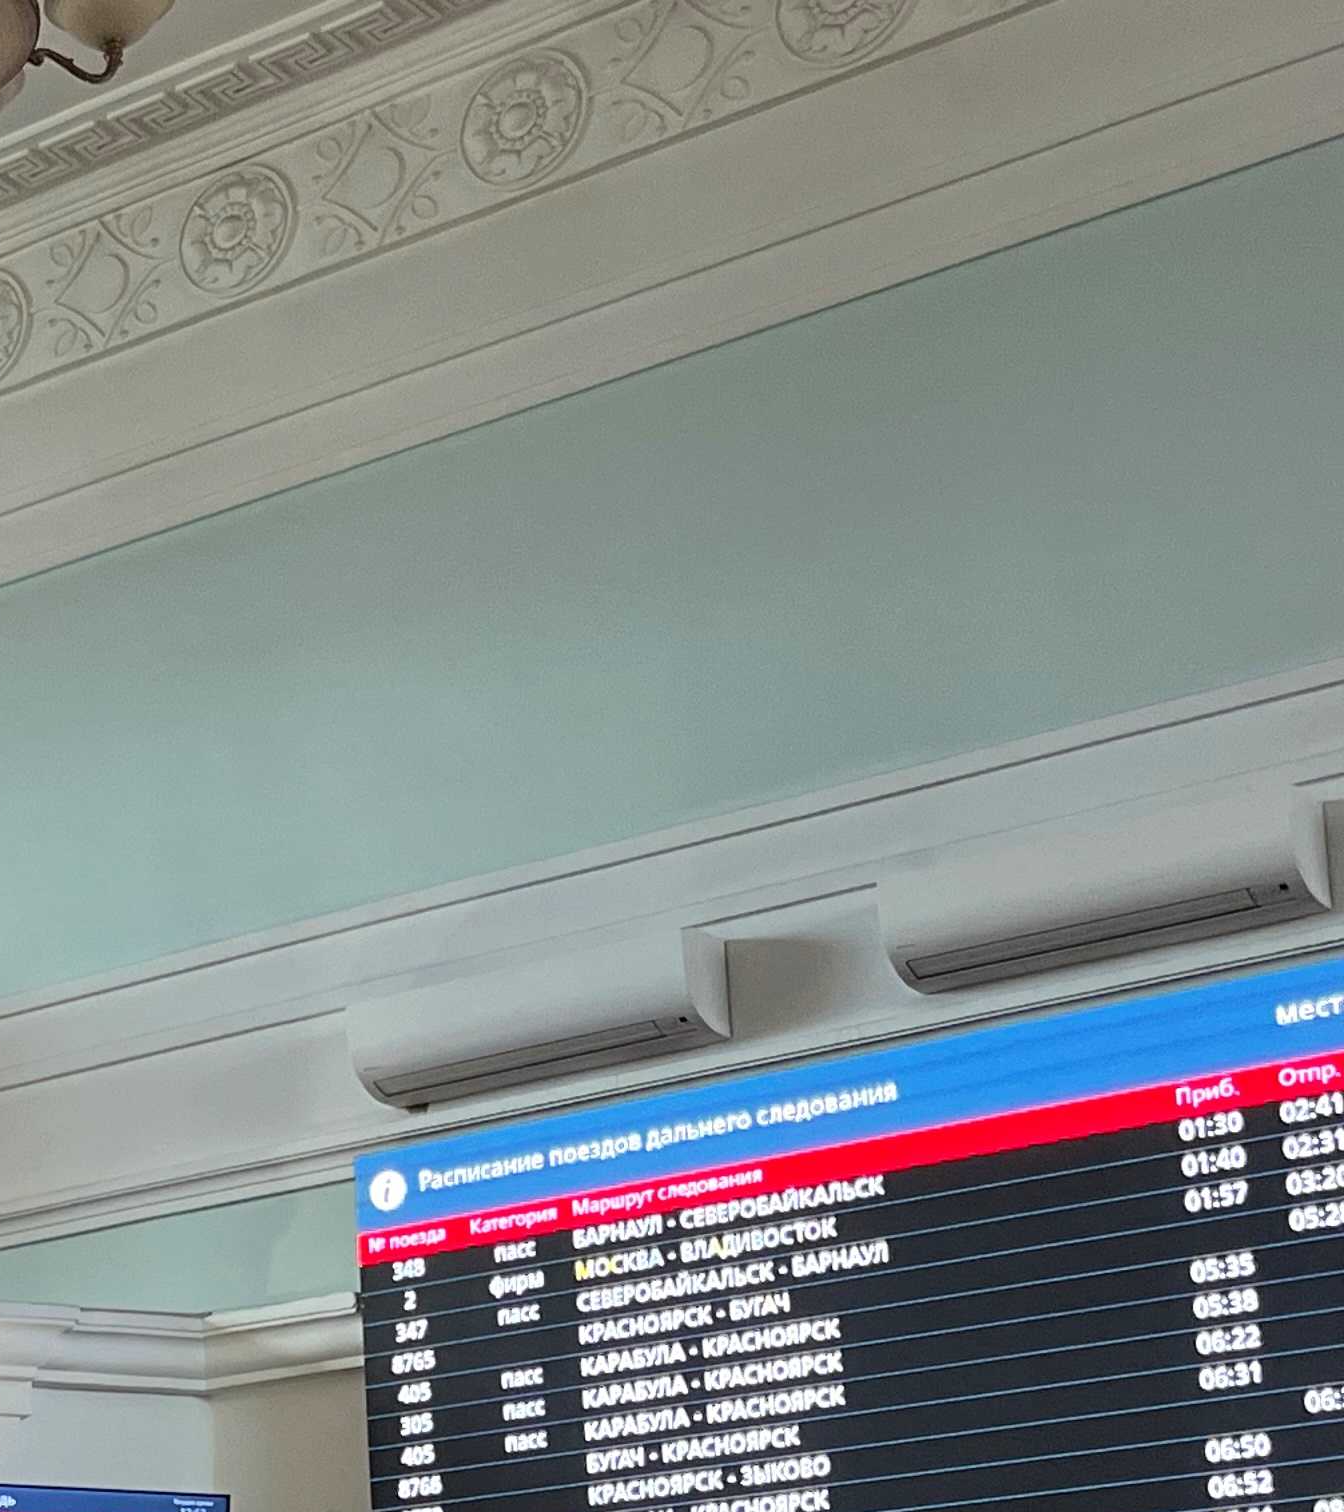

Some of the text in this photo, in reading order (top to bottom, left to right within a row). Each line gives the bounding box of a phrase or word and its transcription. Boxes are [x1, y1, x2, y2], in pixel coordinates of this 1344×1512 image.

[389, 1228, 446, 1248] поезда
[469, 1207, 557, 1234] Категория
[571, 1188, 654, 1215] Маршрут
[657, 1168, 762, 1200] следования
[1175, 1077, 1239, 1107] Приб.
[418, 1082, 897, 1191] Расписание поездов дальнего следования
[493, 1240, 536, 1263] пасс
[572, 1213, 662, 1249] БАРНАУЛ
[678, 1174, 885, 1229] СЕВЕРОБАЙКАЛЬСК
[1178, 1110, 1244, 1141] 01:30
[395, 1182, 1248, 1343] 347 пасс СЕВЕРОБАЙКАЛЬСК БАРНАУЛ 01:57
[403, 1290, 416, 1310] 2
[488, 1269, 544, 1298] фирм
[574, 1247, 664, 1281] МОСКВА
[679, 1216, 837, 1262] ВЛАДИВОСТОК
[1180, 1147, 1246, 1177] 01:40
[500, 1366, 543, 1389] пасс
[580, 1341, 686, 1376] КАРАБУЛА
[701, 1317, 841, 1358] КРАСНОЯРСК
[1189, 1253, 1255, 1283] 05:35
[502, 1398, 545, 1420] пасс
[581, 1374, 688, 1409] КАРАБУЛА
[703, 1350, 843, 1391] КРАСНОЯРСК
[1192, 1289, 1259, 1319] 05:38
[578, 1304, 713, 1345] КРАСНОЯРСК
[728, 1291, 790, 1321] БУГАЧ
[504, 1430, 548, 1452] пасс
[583, 1406, 690, 1441] КАРАБУЛА
[705, 1384, 845, 1424] КРАСНОЯРСК
[1195, 1325, 1261, 1354] 06:22
[585, 1361, 1261, 1473] БУГАЧ КРАСНОЯРСК 06:31
[1204, 1433, 1271, 1462] 06:50
[587, 1468, 724, 1505] КРАСНОЯРСК
[739, 1454, 830, 1486] ЗЫКОВО
[1207, 1469, 1274, 1499] 06:52
